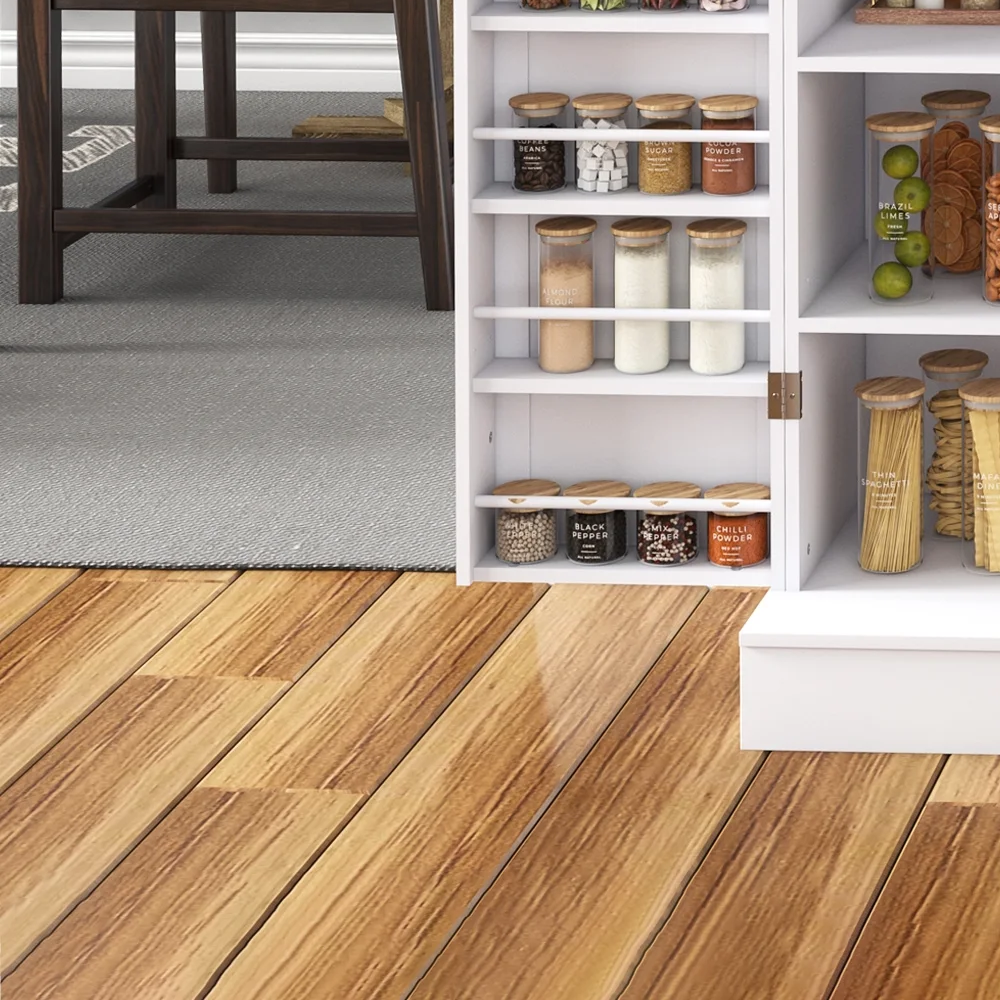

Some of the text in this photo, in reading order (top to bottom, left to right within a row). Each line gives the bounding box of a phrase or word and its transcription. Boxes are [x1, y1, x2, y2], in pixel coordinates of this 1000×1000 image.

[878, 202, 913, 210] BRAZIL
[880, 212, 910, 220] LIMES
[542, 288, 578, 296] ALMOND
[872, 471, 896, 479] THIN
[861, 478, 910, 488] SPAGHETTI
[574, 523, 605, 531] BLACK
[716, 525, 747, 534] CHILLI
[572, 531, 609, 540] PEPPER
[643, 533, 679, 541] PEPPER
[712, 533, 753, 542] POWDER
